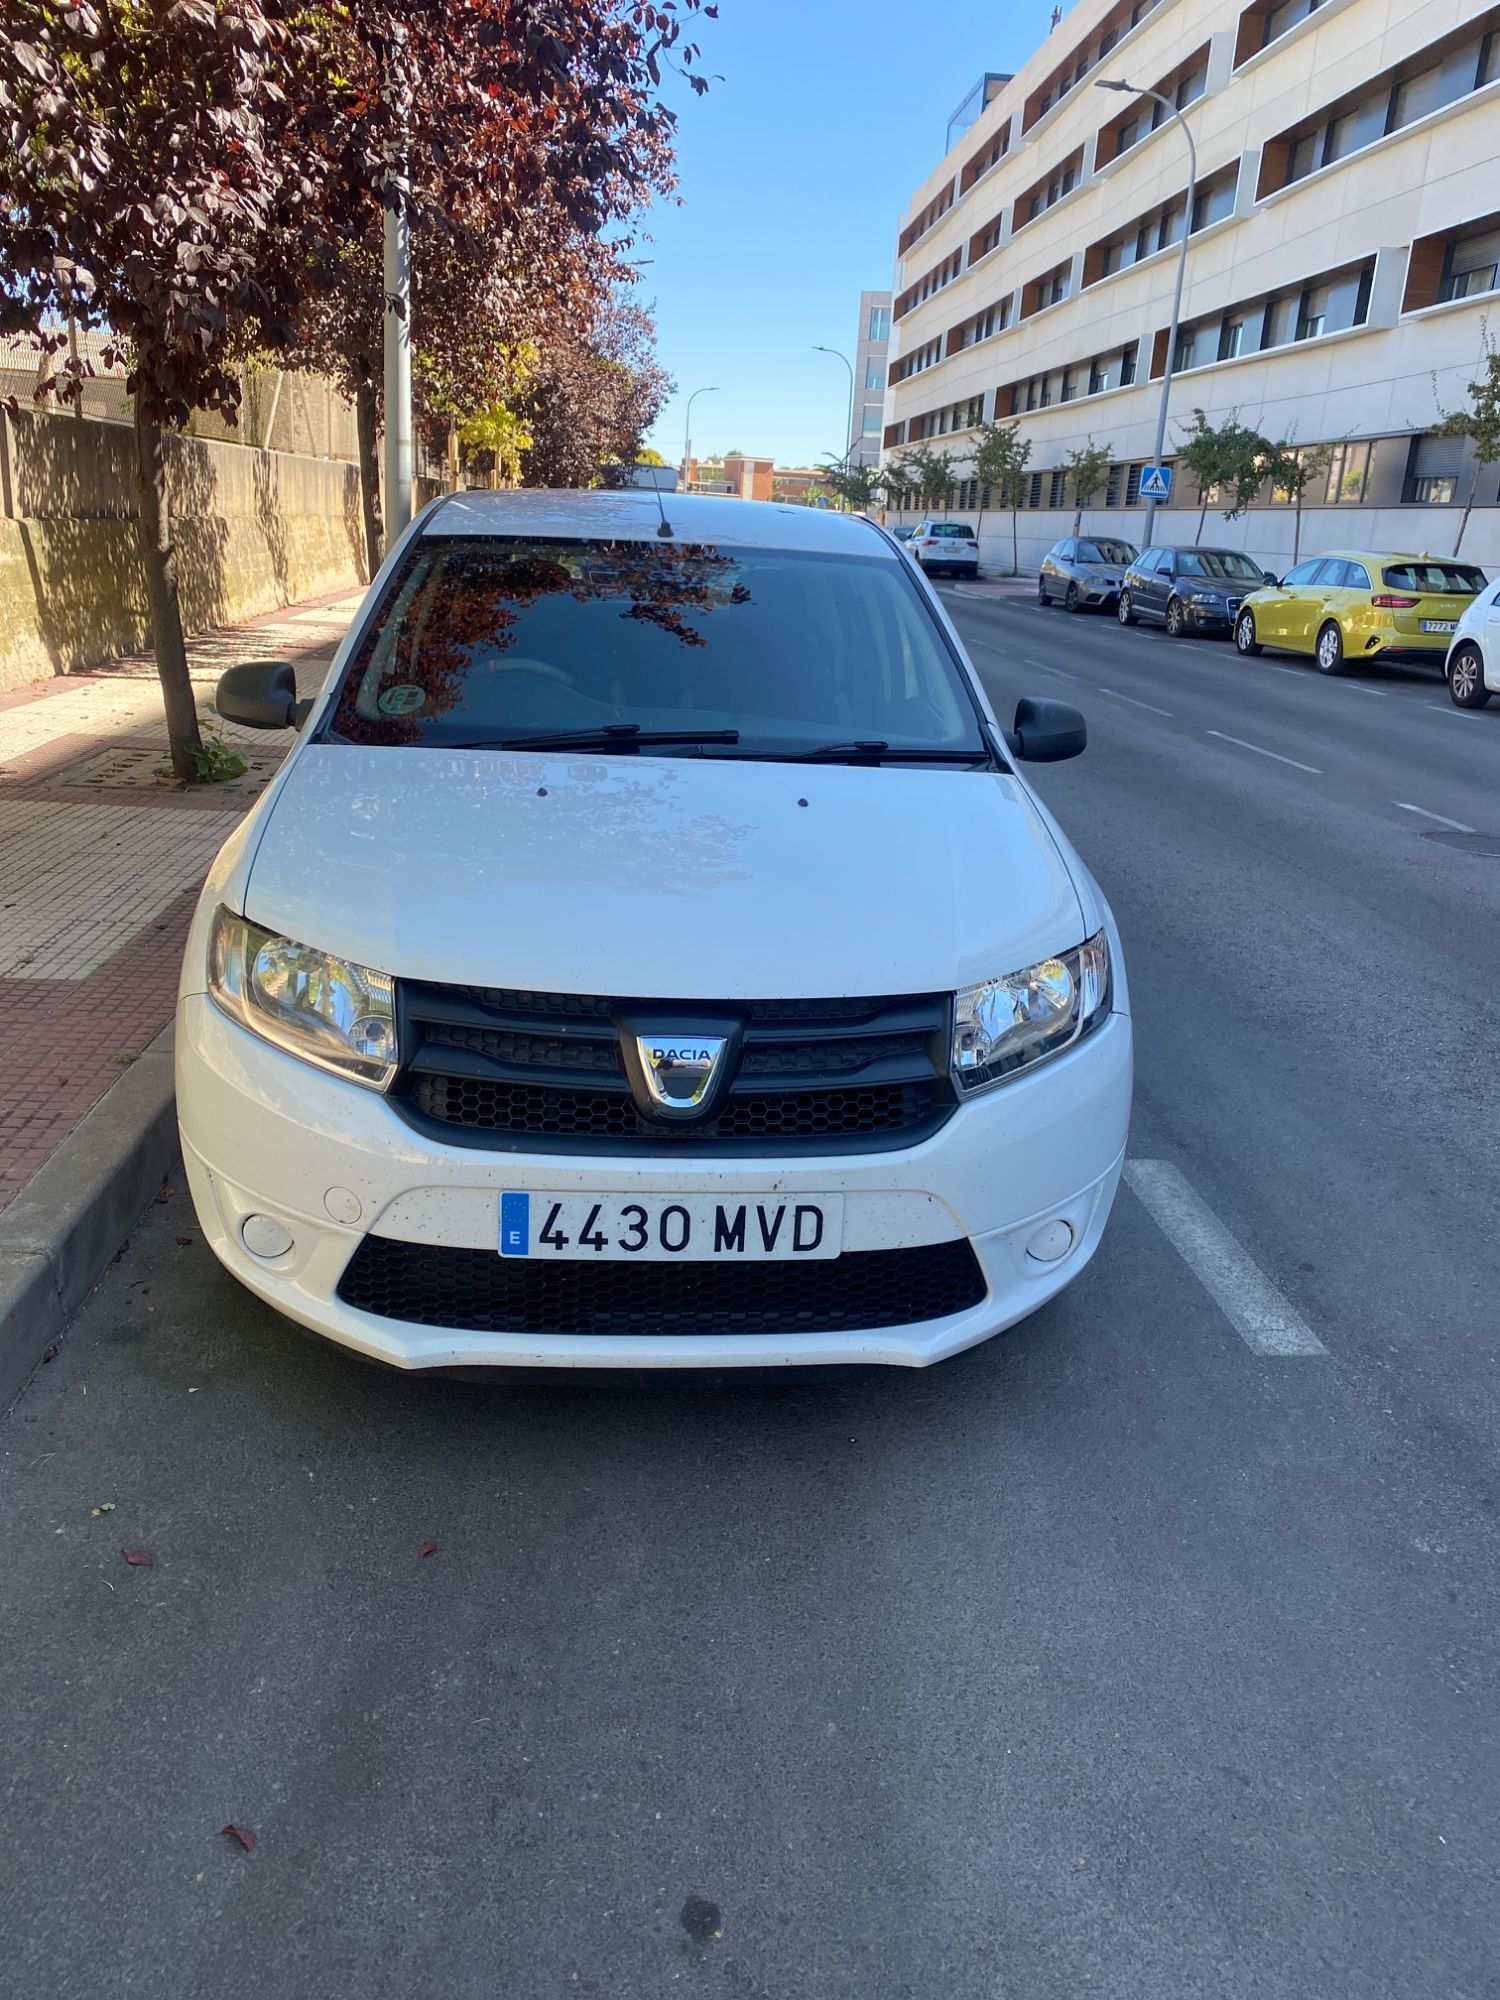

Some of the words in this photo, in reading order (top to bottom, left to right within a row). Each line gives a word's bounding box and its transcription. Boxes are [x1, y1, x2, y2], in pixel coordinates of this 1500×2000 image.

[1428, 622, 1448, 631] 7772
[653, 1049, 711, 1060] DACIA
[538, 1203, 691, 1253] 4430
[713, 1204, 824, 1252] MVD
[510, 1231, 520, 1244] E
